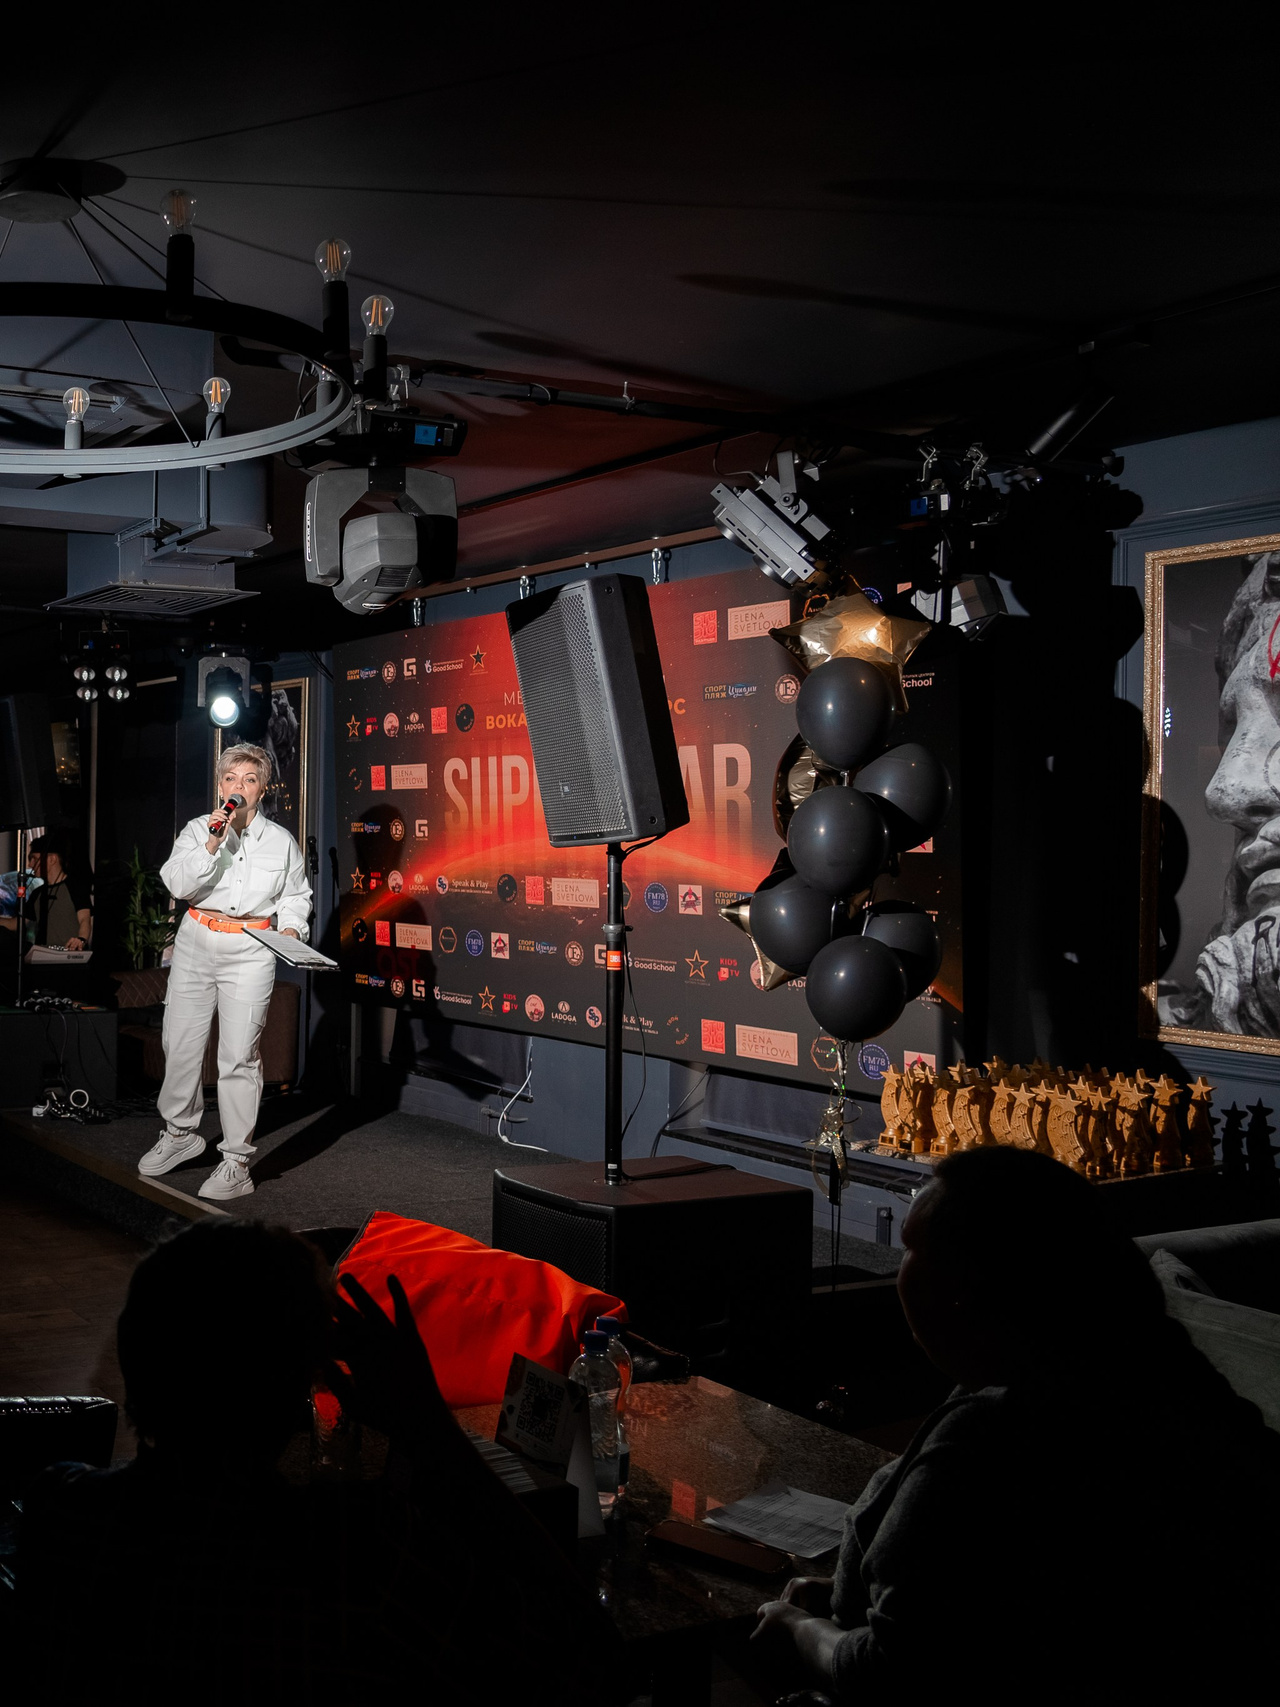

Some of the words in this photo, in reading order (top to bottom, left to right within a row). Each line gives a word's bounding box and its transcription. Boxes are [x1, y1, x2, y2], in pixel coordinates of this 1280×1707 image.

[734, 620, 784, 634] SVETLOVA
[704, 685, 727, 693] СПОРТ
[704, 691, 727, 699] ПЛЯЖ
[486, 714, 527, 730] ВОКА
[452, 879, 470, 889] Speak
[475, 880, 489, 890] Play
[647, 892, 665, 900] FM78
[634, 961, 653, 971] Good
[653, 963, 676, 973] School
[551, 1012, 577, 1023] LADOGA
[741, 1032, 773, 1045] ELENA
[741, 1042, 791, 1059] SVETLOVA
[862, 1054, 886, 1067] FM78
